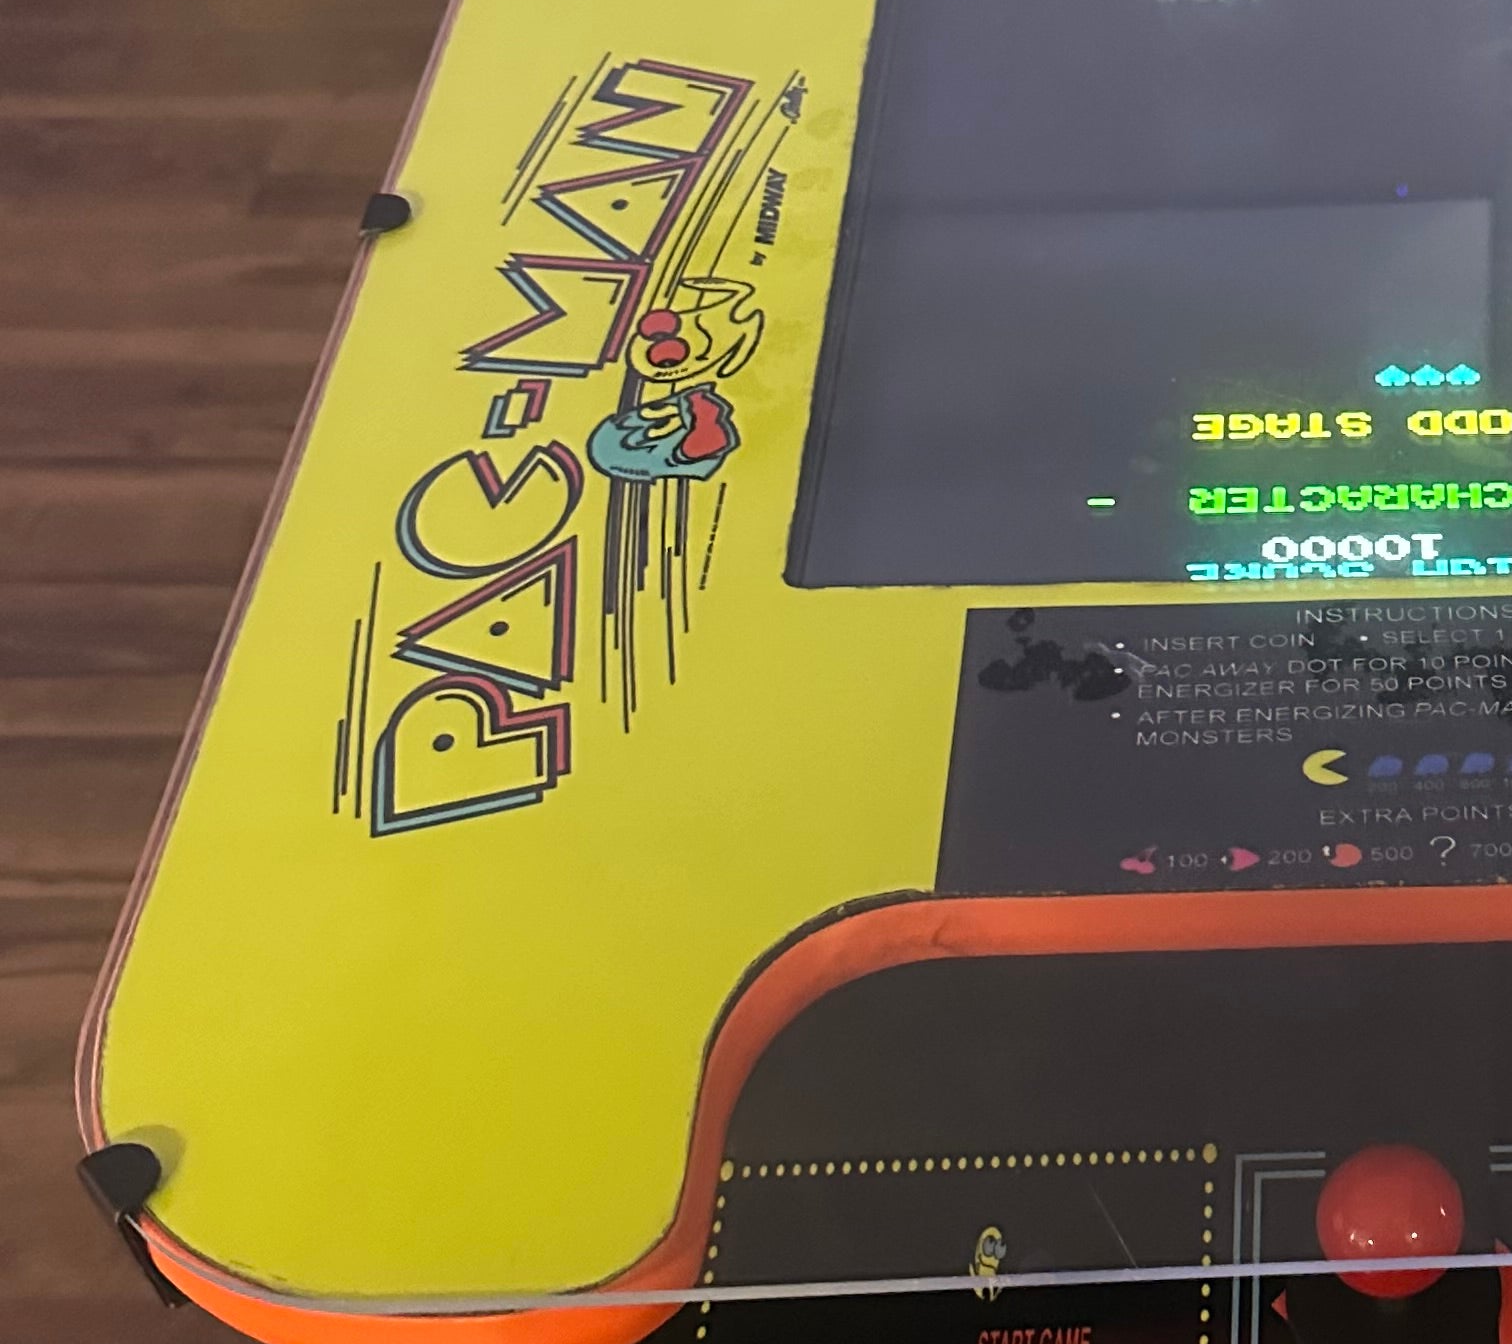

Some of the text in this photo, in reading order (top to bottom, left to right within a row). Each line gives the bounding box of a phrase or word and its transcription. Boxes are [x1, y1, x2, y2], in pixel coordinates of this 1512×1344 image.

[754, 167, 788, 246] MIDWAY
[1192, 410, 1373, 443] STAGE
[371, 59, 754, 838] PAC-MAN
[1261, 533, 1443, 562] 10000
[1143, 632, 1315, 652] INSERT COIN
[1382, 629, 1482, 646] SELECT
[1139, 663, 1193, 680] PAC
[1202, 661, 1275, 678] AWAY
[1287, 659, 1343, 674] DOT
[1353, 657, 1407, 673] FOR
[1420, 656, 1446, 671] 10
[1138, 674, 1508, 700] ENERGIZER FOR 50 POINTS
[1138, 708, 1227, 726] AFTER
[1236, 702, 1405, 723] ENERGIZING
[1136, 727, 1294, 747] MONSTERS
[1319, 807, 1413, 826] EXTRA
[1168, 853, 1209, 868] 100
[1268, 850, 1312, 865] 200
[1370, 846, 1414, 862] 500
[1429, 835, 1457, 867] ?
[1471, 842, 1512, 858] 700
